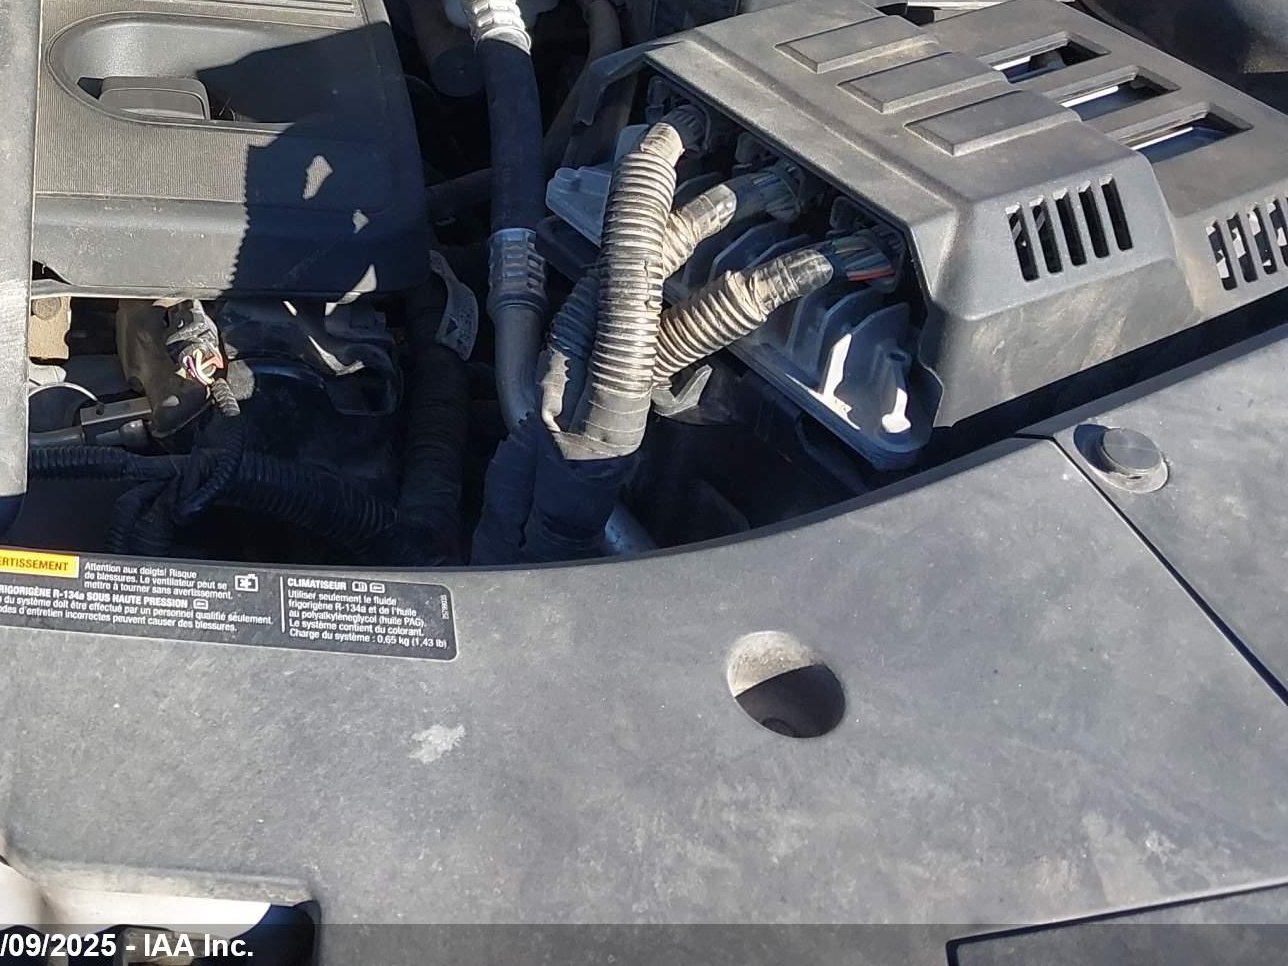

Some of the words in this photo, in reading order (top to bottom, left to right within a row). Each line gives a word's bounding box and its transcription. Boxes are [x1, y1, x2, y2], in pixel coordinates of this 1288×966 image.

[84, 562, 121, 573] Attention
[123, 566, 138, 574] aux
[139, 567, 167, 577] doigts!
[169, 569, 198, 579] Risque
[84, 571, 94, 580] de
[96, 572, 138, 583] blessures.
[139, 575, 150, 584] Le
[152, 577, 195, 587] ventilateur
[196, 580, 216, 590] peut
[217, 582, 227, 590] se
[84, 580, 111, 590] mettre
[120, 583, 150, 593] tourner
[152, 586, 171, 595] sans
[172, 588, 233, 600] avertissement.
[287, 578, 347, 591] CLIMATISEUR
[52, 588, 85, 601] R-134a
[86, 591, 111, 602] SOUS
[112, 594, 142, 605] HAUTE
[143, 596, 188, 609] PRESSION
[288, 589, 316, 600] Utiliser
[318, 593, 362, 604] seulement
[363, 595, 372, 604] le
[373, 596, 397, 606] fluide
[4, 594, 15, 604] du
[16, 596, 51, 608] système
[53, 598, 69, 609] doit
[88, 602, 123, 613] effectué
[124, 606, 138, 615] par
[140, 607, 151, 615] un
[152, 607, 194, 618] personnel
[195, 611, 226, 621] qualifié
[227, 614, 274, 625] seulement.
[288, 598, 333, 611] frigorigène
[335, 602, 367, 613] R-134a
[368, 606, 377, 614] et
[378, 606, 389, 614] de
[391, 607, 417, 617] l'huile
[18, 605, 63, 618] d'entretien
[65, 610, 111, 622] incorrectes
[112, 614, 146, 625] peuvent
[148, 617, 176, 627] causer
[177, 619, 193, 628] des
[195, 620, 238, 632] blessures.
[288, 610, 299, 618] au
[378, 615, 402, 626] (huile
[403, 617, 427, 628] PAG).
[289, 618, 300, 627] Le
[301, 620, 337, 630] système
[338, 623, 373, 634] contient
[374, 625, 386, 634] du
[387, 626, 424, 637] colorant.
[289, 628, 320, 640] Charge
[321, 630, 333, 640] du
[334, 632, 370, 643] système
[398, 636, 410, 647] kg
[435, 639, 447, 650] lb)
